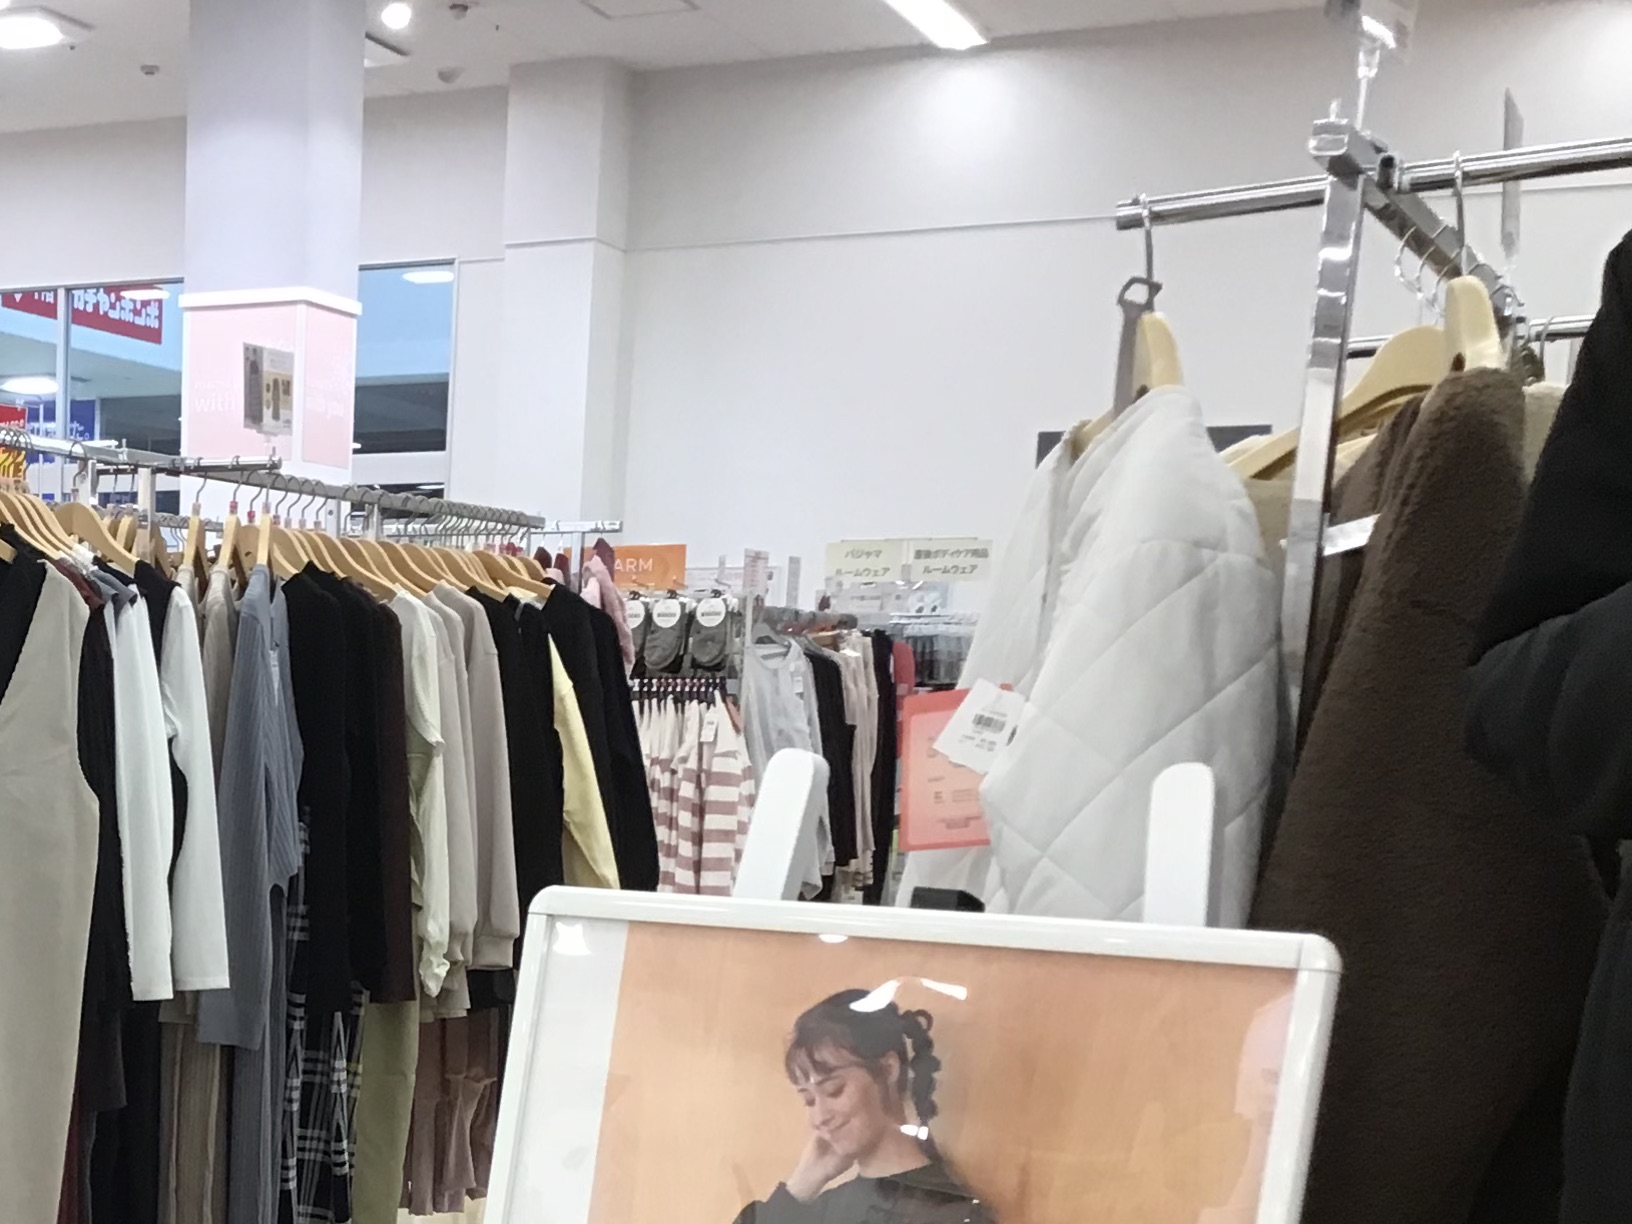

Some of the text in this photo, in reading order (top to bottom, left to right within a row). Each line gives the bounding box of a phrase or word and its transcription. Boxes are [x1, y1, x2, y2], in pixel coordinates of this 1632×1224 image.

[614, 558, 653, 572] ARM
[922, 564, 978, 574] ルームウェア
[835, 567, 891, 577] ルームウェア
